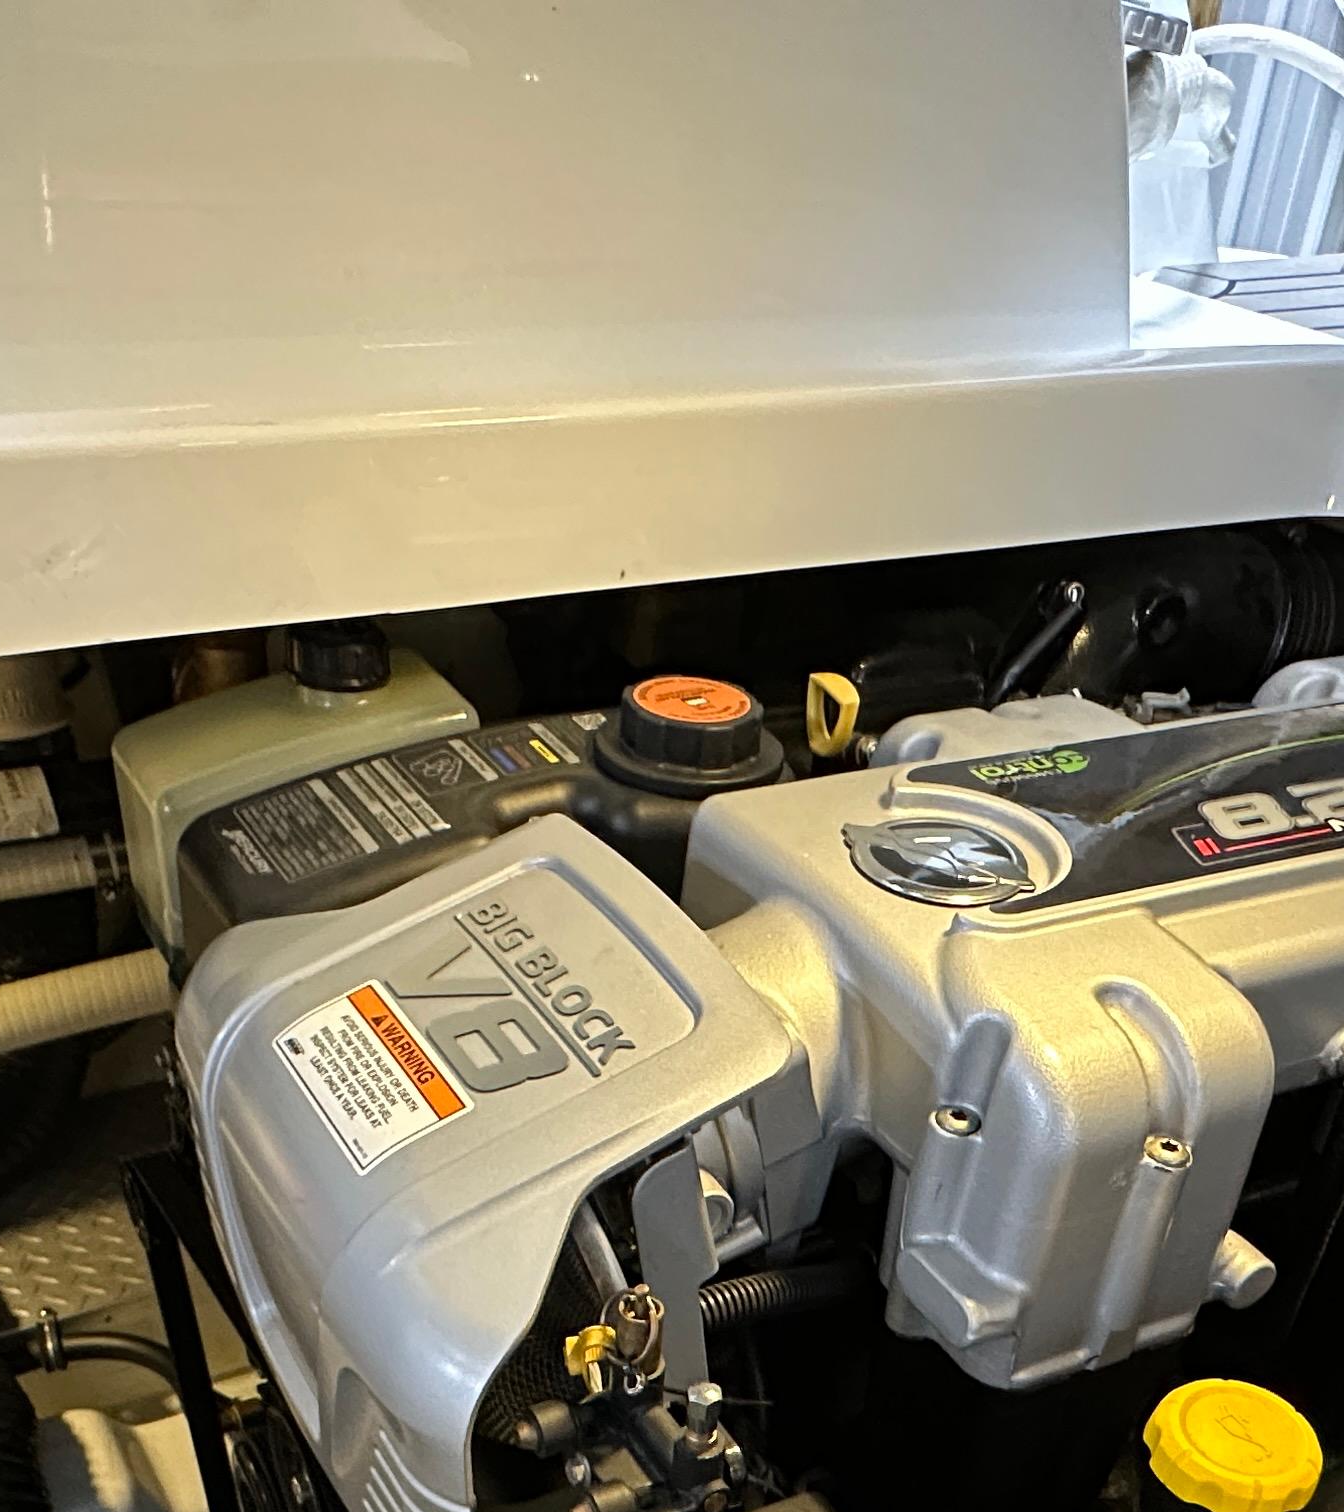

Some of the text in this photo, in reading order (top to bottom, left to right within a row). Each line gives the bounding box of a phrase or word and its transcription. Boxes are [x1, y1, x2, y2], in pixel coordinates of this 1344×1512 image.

[384, 920, 569, 1094] V8
[467, 902, 637, 1066] BIG BLOCK
[310, 1057, 329, 1075] LEAST
[324, 1075, 341, 1095] ONCE
[340, 1029, 354, 1047] FROM
[360, 1060, 372, 1069] OR
[367, 1069, 398, 1106] EXPLOSION
[343, 1057, 360, 1076] FROM
[355, 1078, 380, 1104] LEAKING
[354, 1031, 378, 1057] SERIOUS
[374, 1056, 394, 1077] INJURY
[390, 1078, 402, 1089] OR
[397, 1088, 418, 1112] DEATH
[381, 1022, 436, 1086] WARNING
[345, 1082, 359, 1097] FOR
[354, 1096, 375, 1120] LEAKS
[370, 1119, 382, 1128] AT
